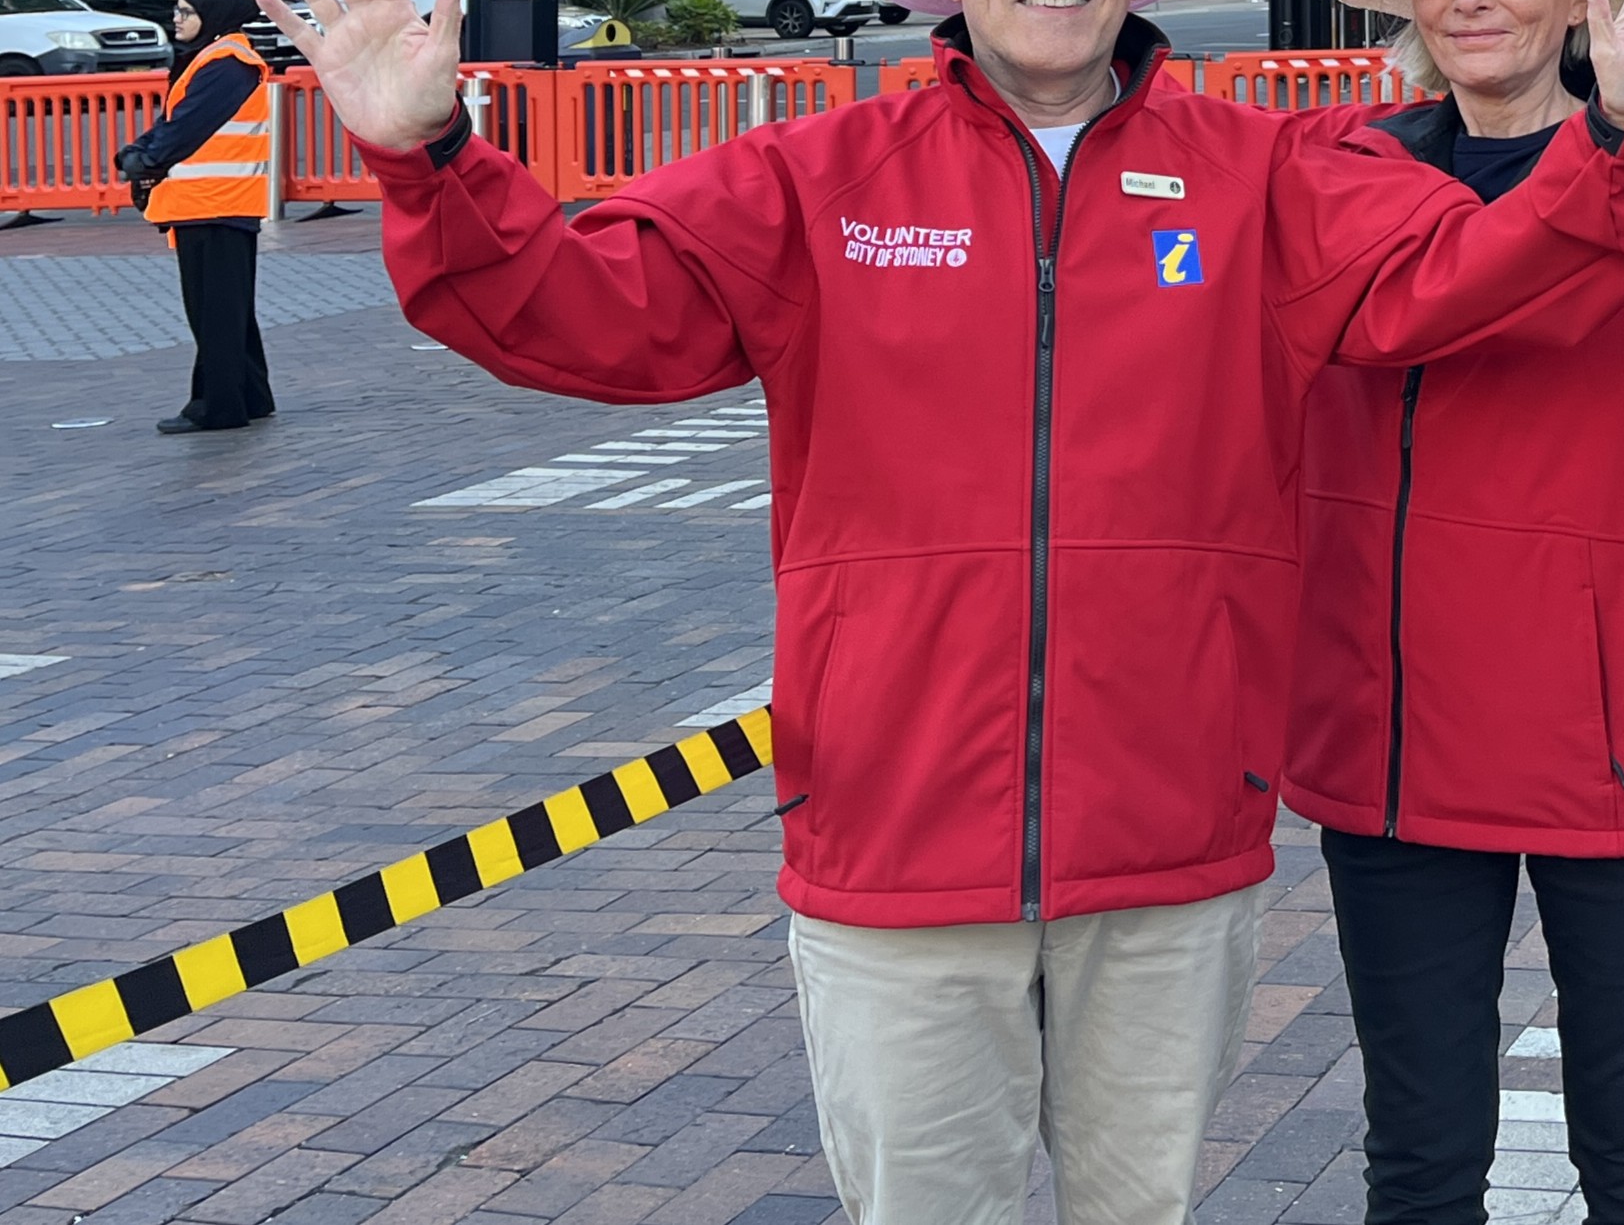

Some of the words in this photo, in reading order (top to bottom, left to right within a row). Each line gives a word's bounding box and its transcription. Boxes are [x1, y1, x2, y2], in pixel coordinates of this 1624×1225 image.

[1125, 178, 1156, 189] Michael
[840, 216, 972, 246] VOLUNTEER
[845, 240, 876, 265] CITY
[875, 248, 893, 267] OF
[893, 246, 944, 267] SYDNEY
